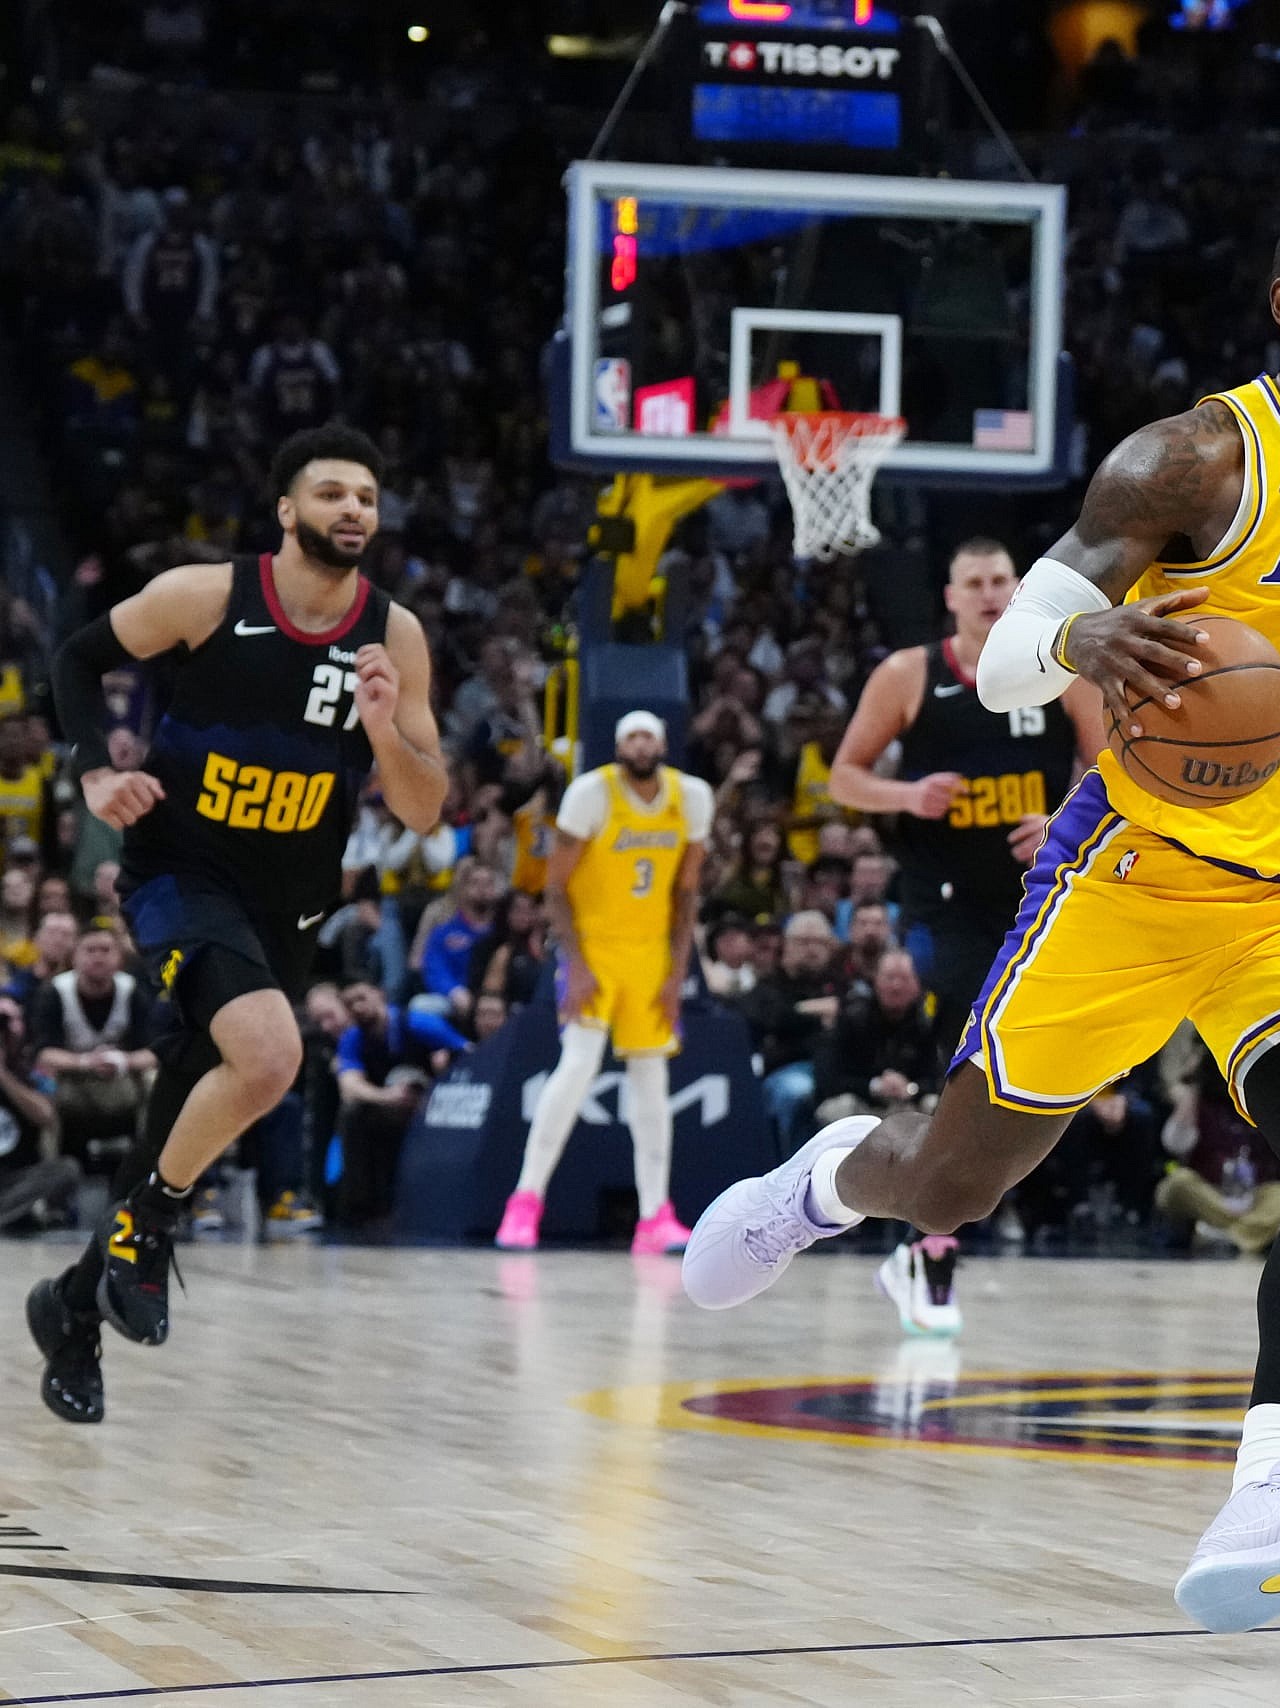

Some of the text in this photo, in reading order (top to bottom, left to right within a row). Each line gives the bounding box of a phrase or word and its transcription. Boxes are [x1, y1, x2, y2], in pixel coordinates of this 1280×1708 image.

[756, 41, 900, 80] TISSOT
[303, 664, 362, 732] 27
[1008, 706, 1046, 738] 15
[195, 751, 337, 834] 5280
[951, 770, 1047, 830] 5280
[631, 858, 655, 899] 3
